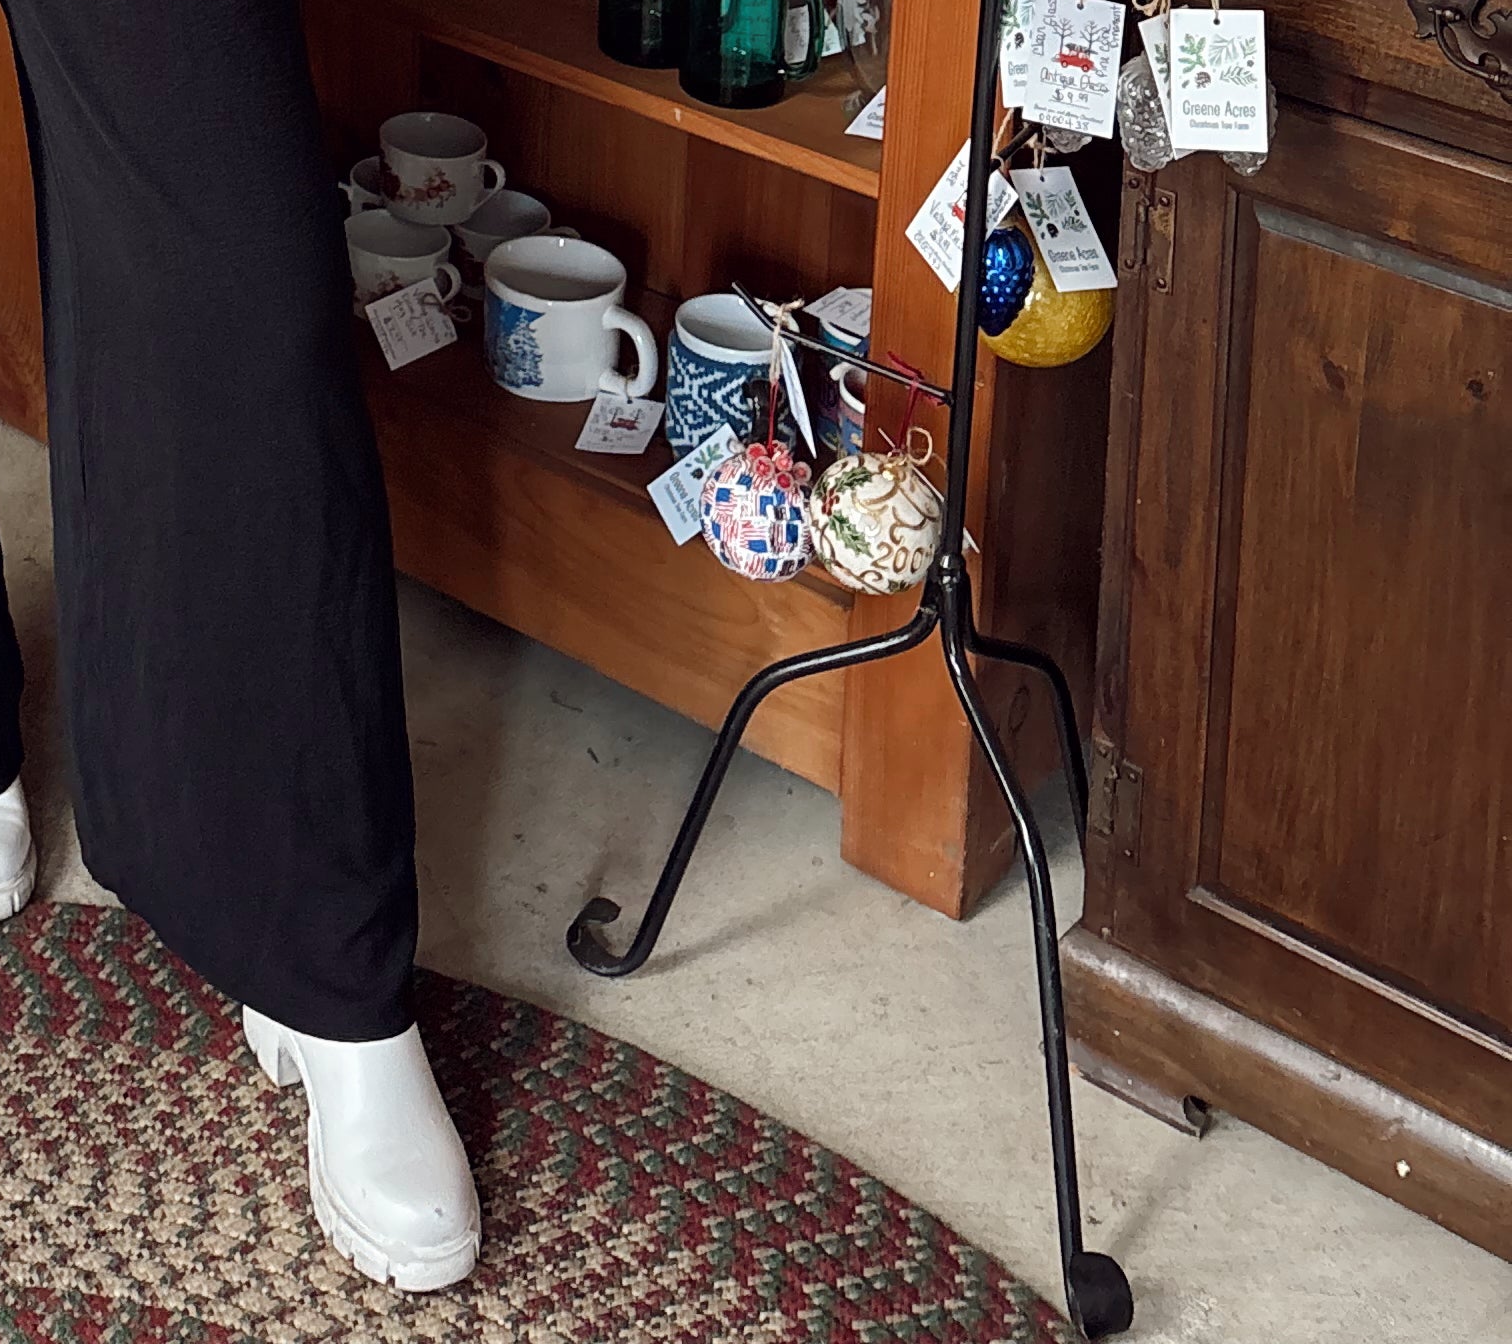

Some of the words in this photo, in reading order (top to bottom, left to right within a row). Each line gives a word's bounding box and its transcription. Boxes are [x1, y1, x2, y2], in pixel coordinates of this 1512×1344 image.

[1008, 62, 1028, 75] Green
[1182, 99, 1220, 116] Greene
[1224, 100, 1256, 118] Acres
[1048, 248, 1076, 262] Greene
[1077, 247, 1099, 260] Acres
[672, 471, 688, 501] Greene
